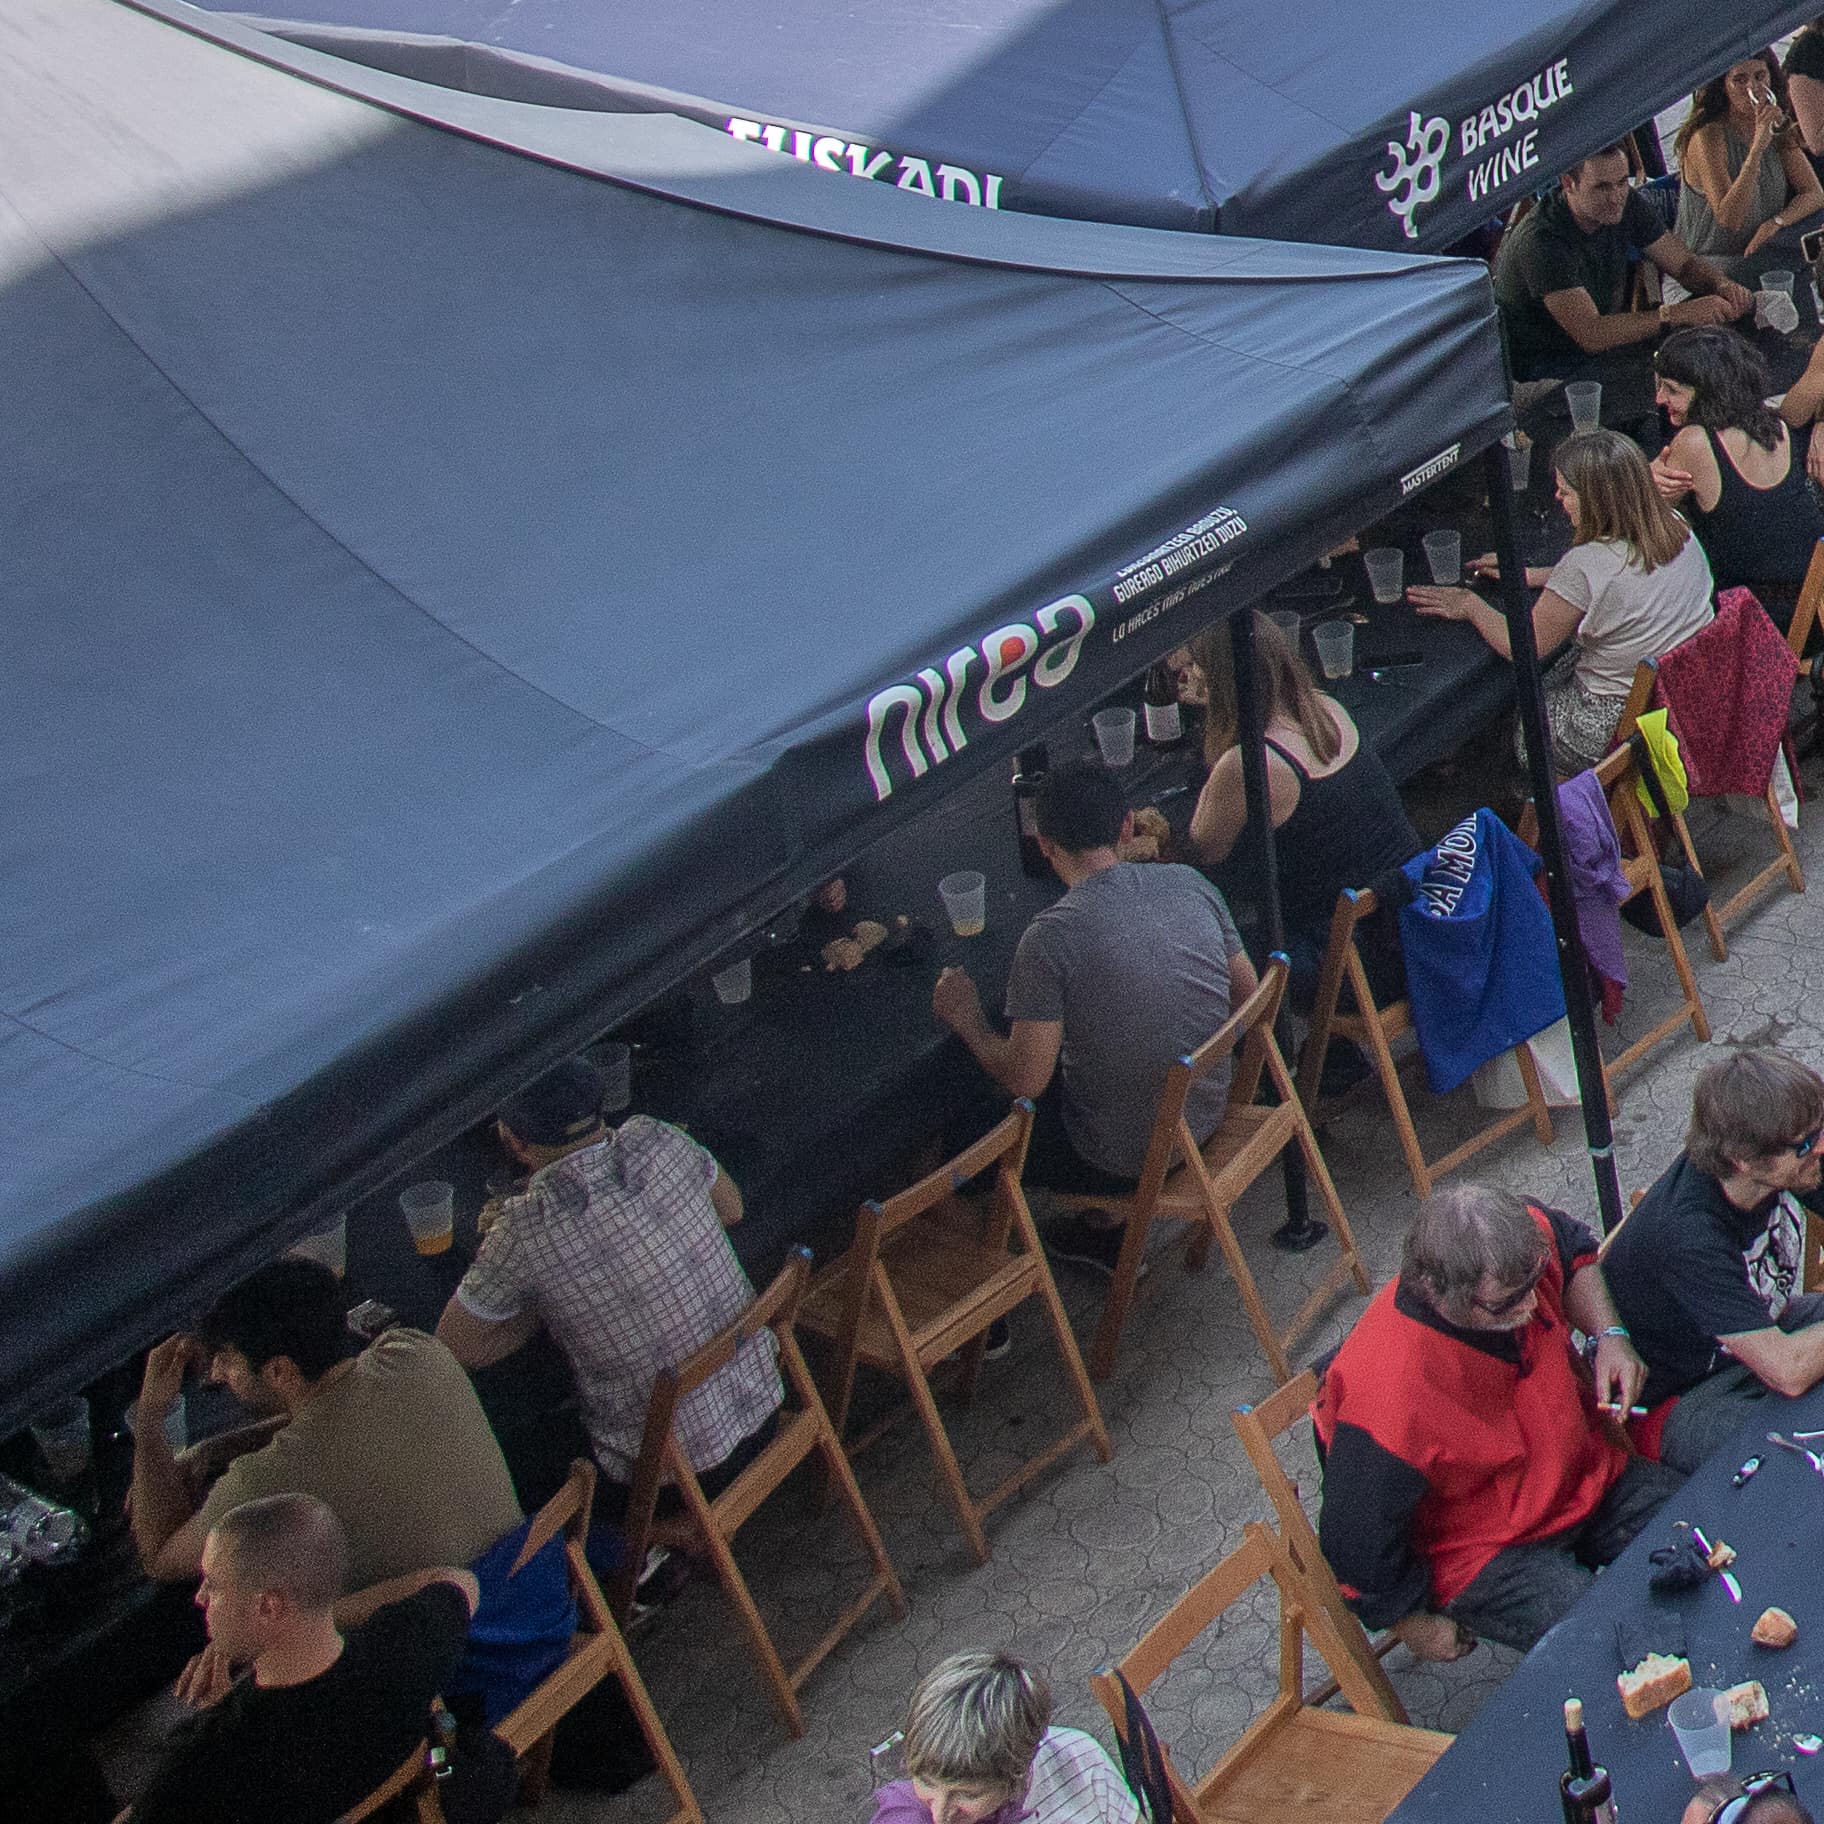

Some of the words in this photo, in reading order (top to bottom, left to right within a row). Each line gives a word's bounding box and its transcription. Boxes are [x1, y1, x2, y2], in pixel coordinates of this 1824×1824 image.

[1459, 57, 1574, 156] BASQUE
[1467, 129, 1541, 202] WINE
[1402, 448, 1459, 495] MASTERTENT
[1113, 564, 1163, 603] GUREAGO
[1160, 532, 1220, 576] BIHURTZEN
[1215, 516, 1247, 542] DUZU
